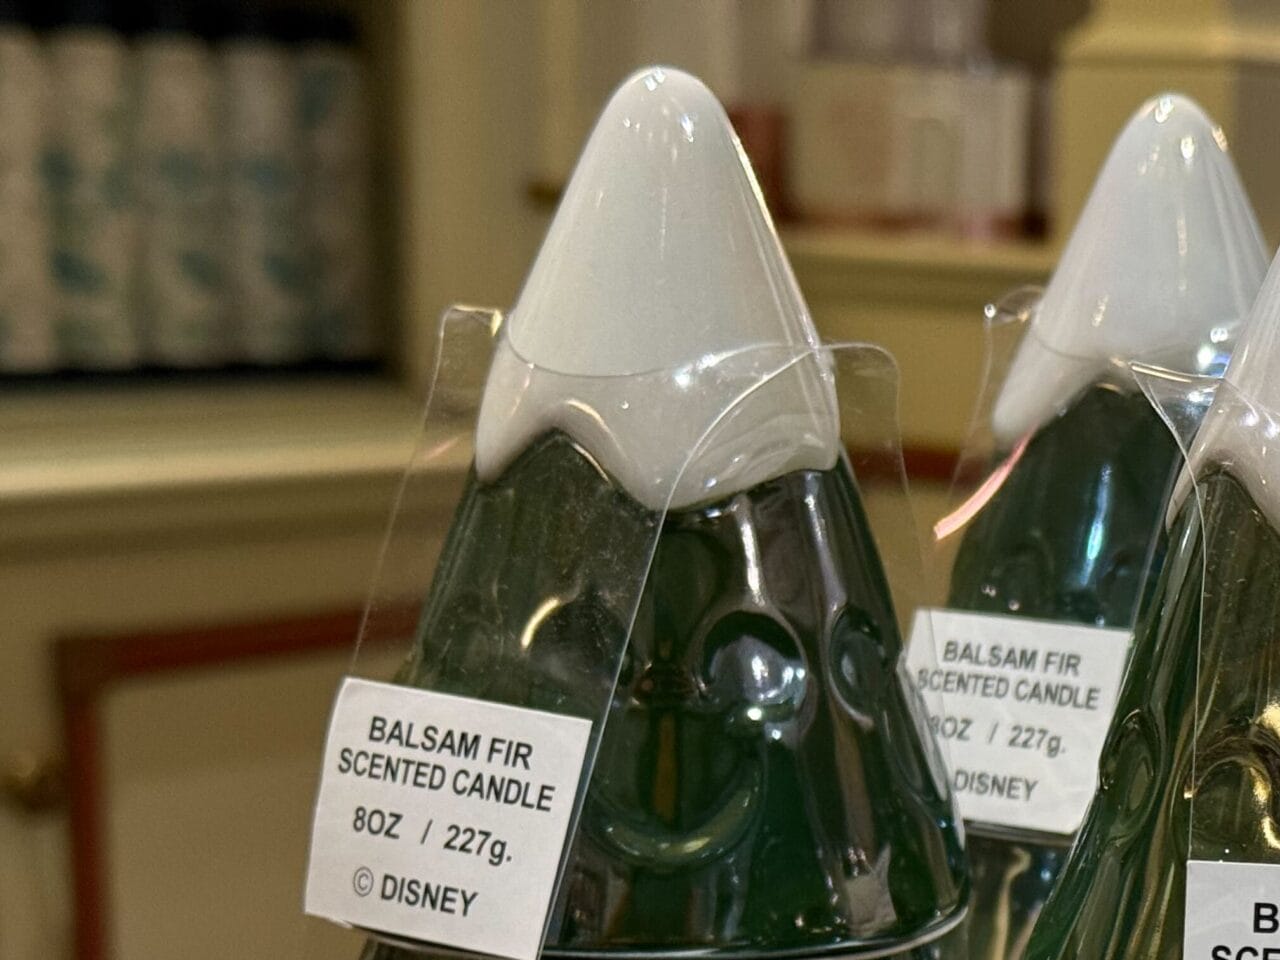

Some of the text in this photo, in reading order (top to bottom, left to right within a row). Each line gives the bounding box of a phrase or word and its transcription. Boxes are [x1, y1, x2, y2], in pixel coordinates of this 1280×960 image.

[943, 640, 1081, 676] BALSAM FIR
[917, 669, 1099, 710] SCENTED CANDLE
[369, 716, 533, 770] BALSAM FIR
[989, 723, 998, 743] /
[1008, 725, 1065, 757] 227g.
[338, 748, 555, 812] SCENTED CANDLE
[954, 770, 1039, 801] DISNEY
[353, 806, 512, 866] 8OZ / 227g.
[380, 874, 478, 916] DISNEY
